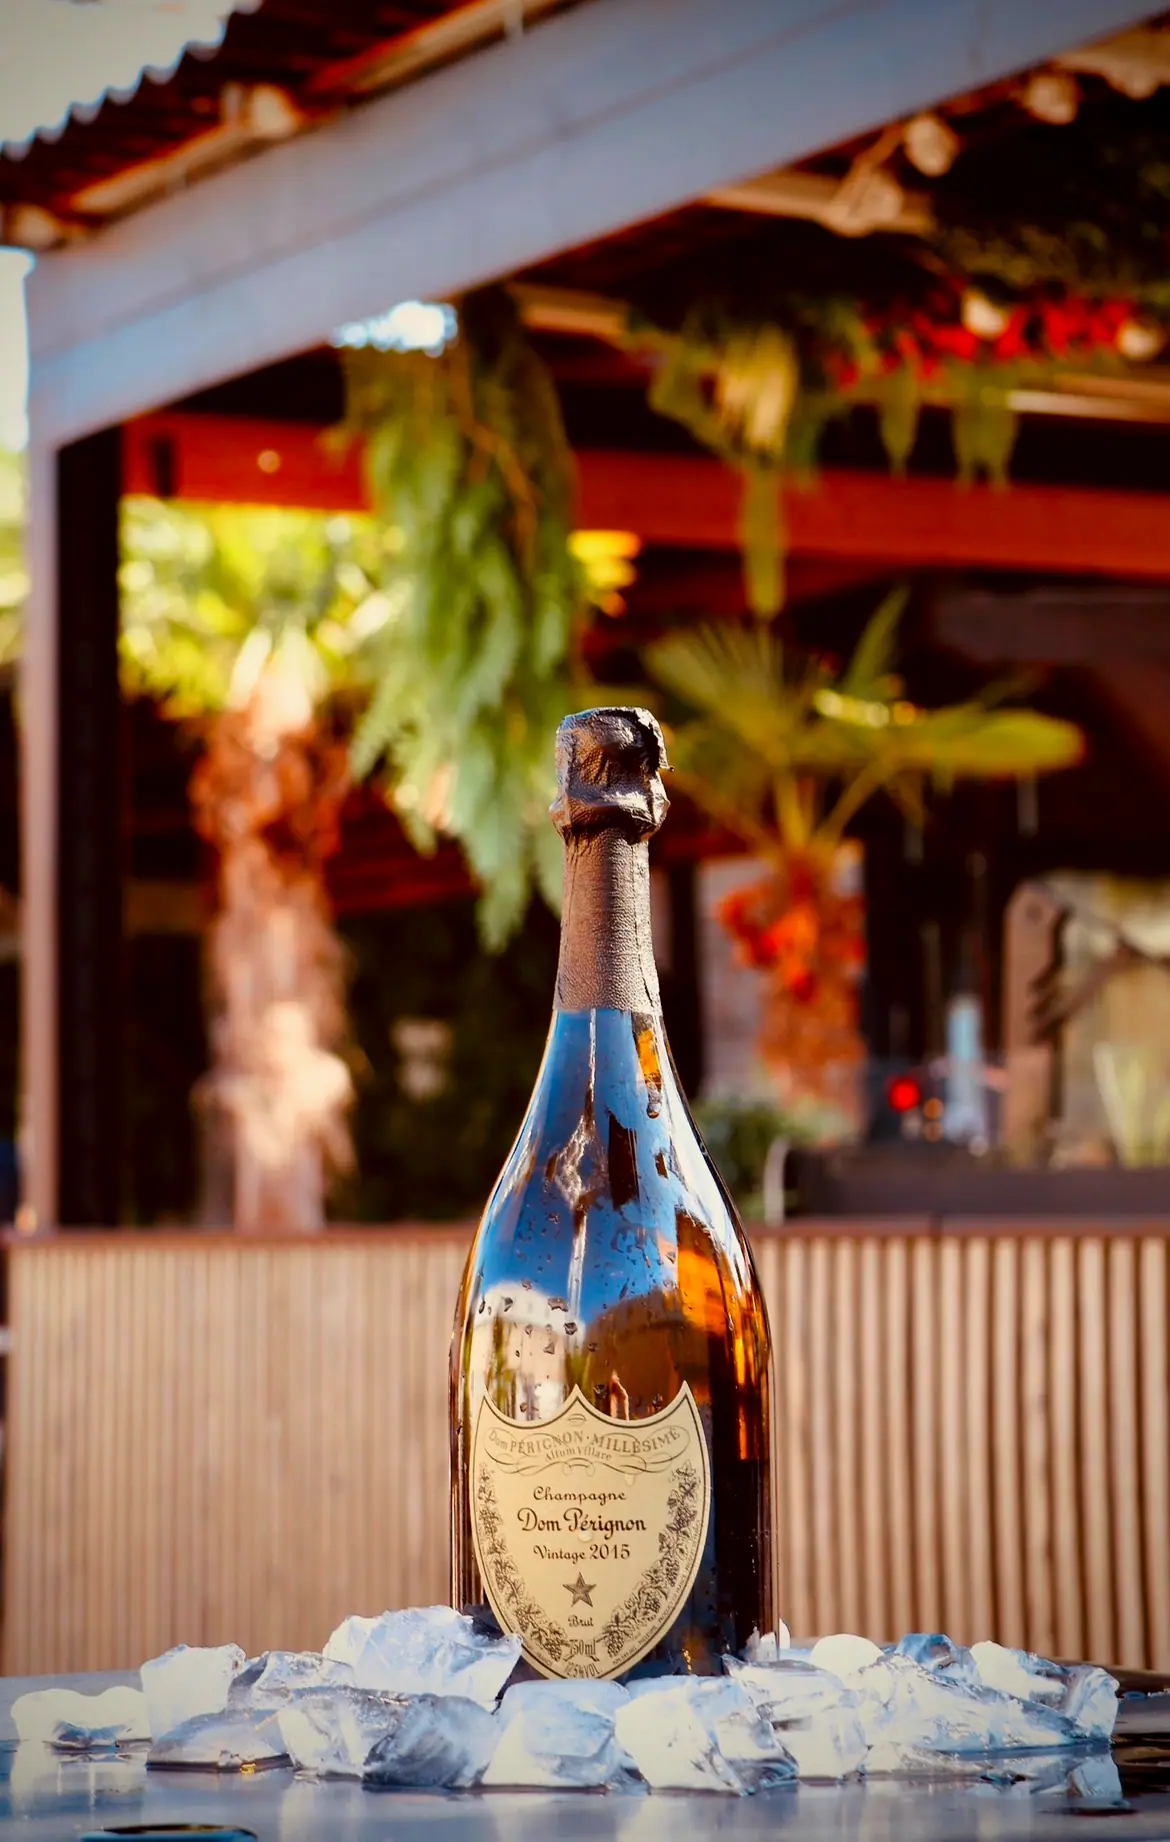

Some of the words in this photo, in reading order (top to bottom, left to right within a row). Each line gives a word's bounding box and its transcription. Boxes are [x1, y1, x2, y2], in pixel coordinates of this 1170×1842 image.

[532, 1485, 627, 1506] Champagne
[517, 1507, 562, 1532] Dom
[563, 1507, 647, 1541] Pérignon
[533, 1544, 587, 1565] Vintage
[589, 1543, 631, 1560] 2015
[567, 1614, 594, 1627] Brut
